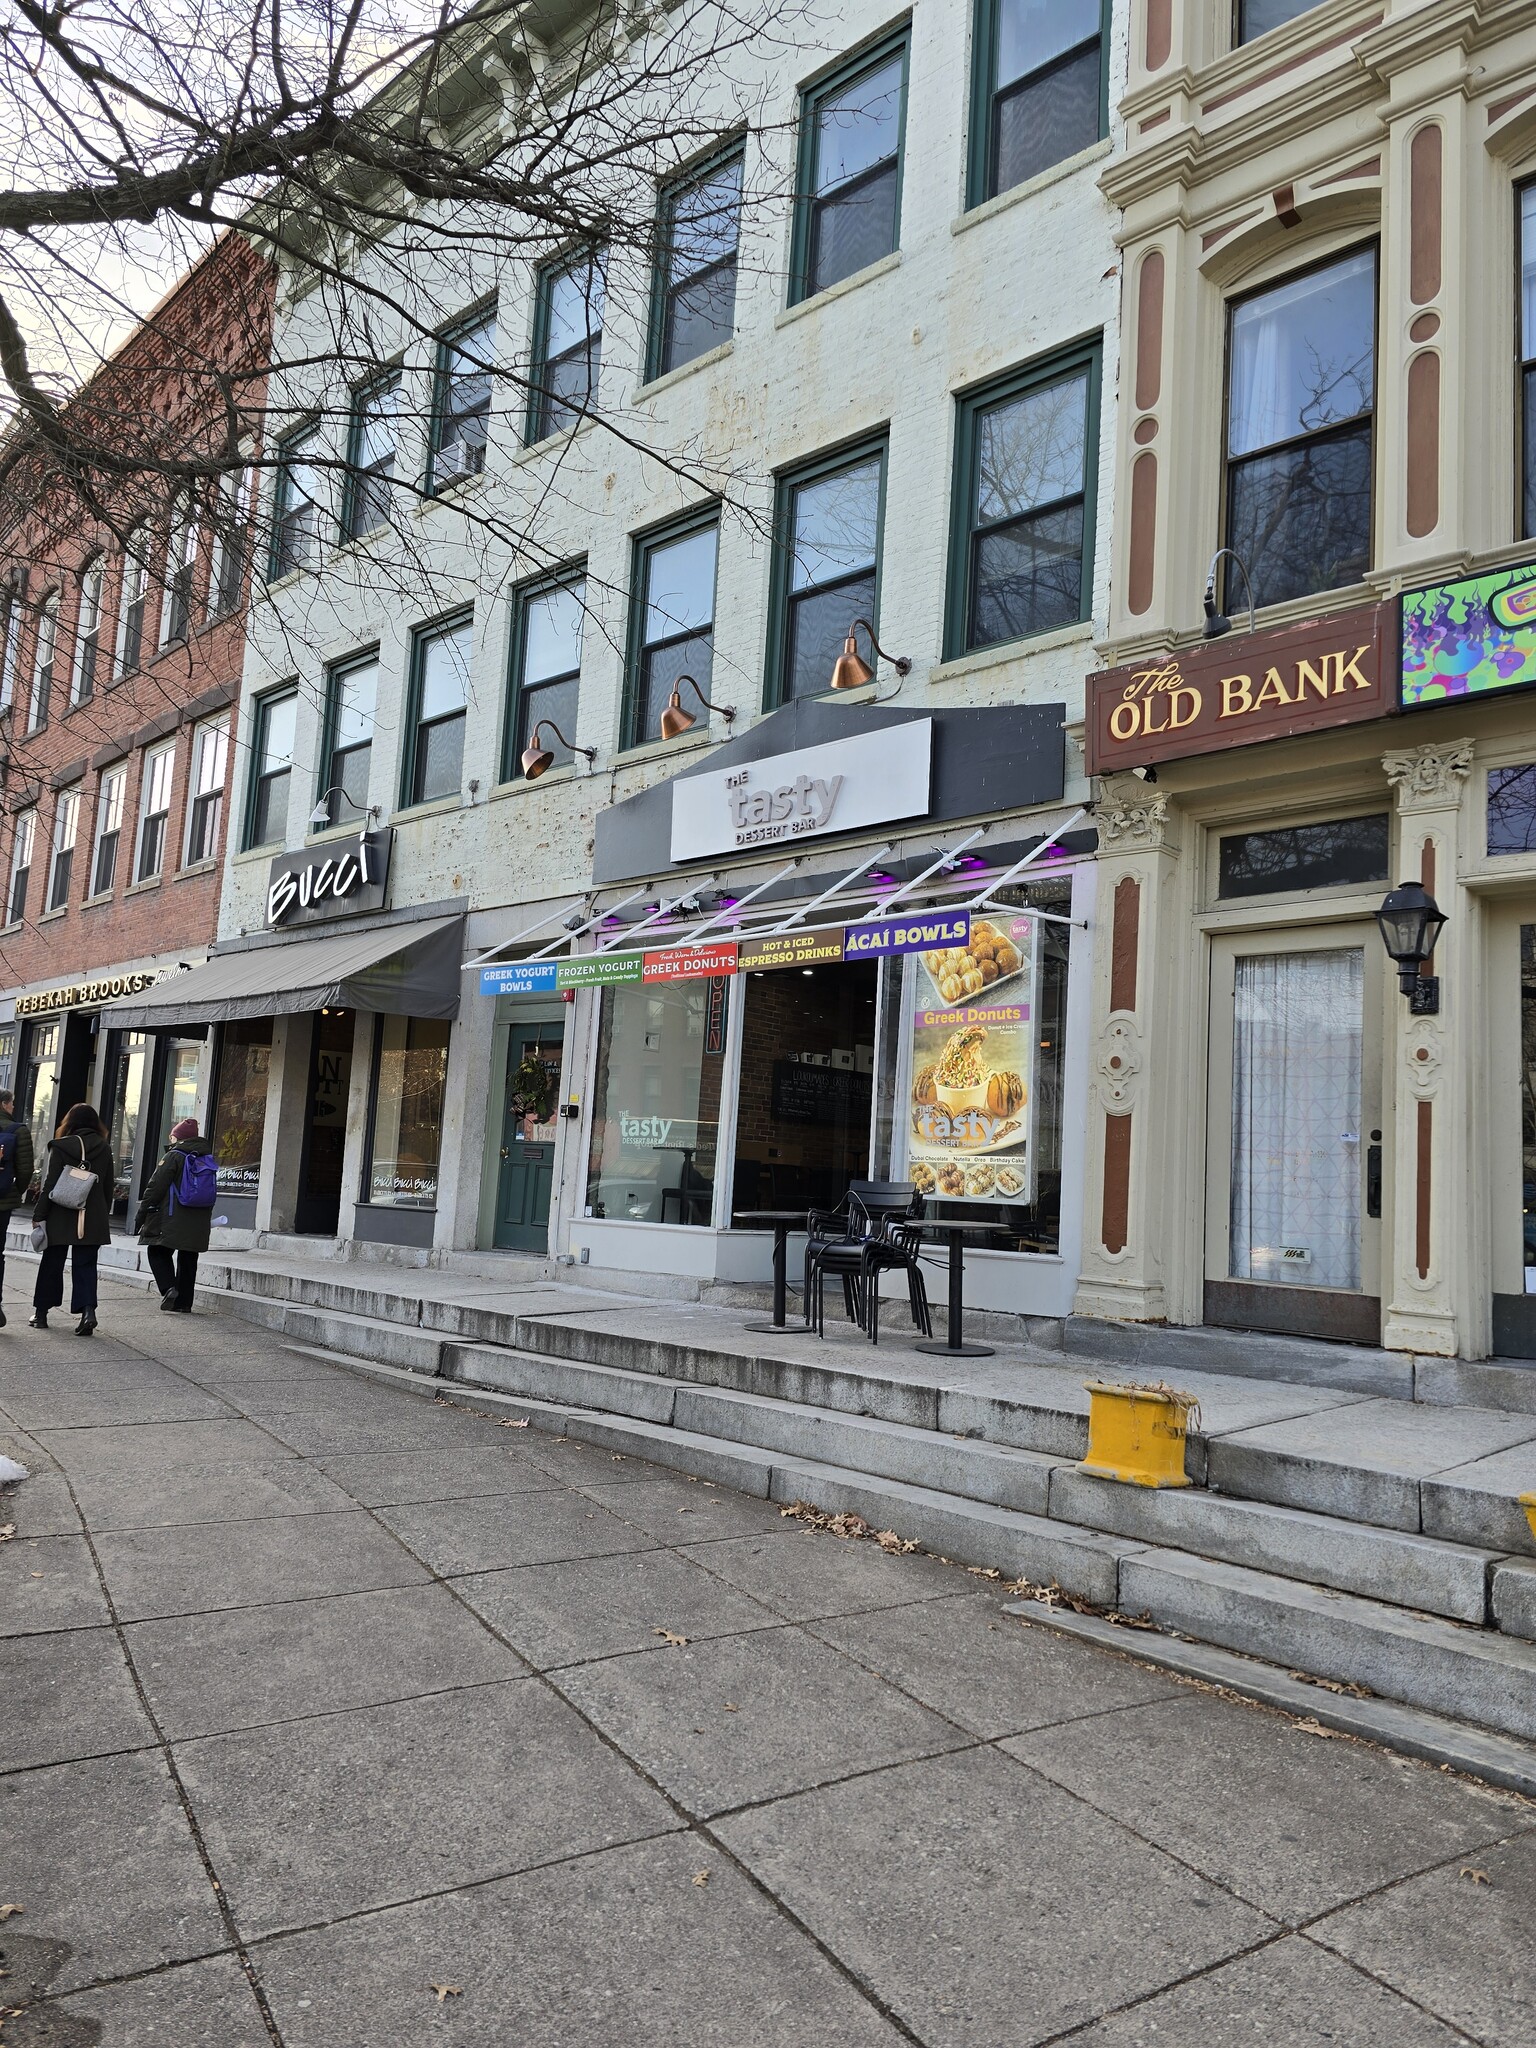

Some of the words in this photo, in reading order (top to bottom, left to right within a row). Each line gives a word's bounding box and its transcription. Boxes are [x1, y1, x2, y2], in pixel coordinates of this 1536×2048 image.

[1122, 662, 1185, 701] The
[1109, 687, 1202, 740] OLD
[1219, 645, 1372, 719] BANK
[724, 770, 749, 789] THE
[728, 775, 846, 828] tasty
[735, 824, 788, 845] DESSERT
[791, 818, 816, 833] BAR
[894, 920, 967, 946] BOWLS
[763, 942, 782, 951] HOT
[783, 940, 790, 948] &
[792, 937, 815, 948] ICED
[643, 960, 680, 975] GREEK
[684, 955, 736, 971] DONUTS
[738, 951, 793, 968] ESPRESSO
[796, 945, 841, 961] DRINKS
[483, 967, 514, 981] GREEK
[515, 966, 555, 979] YOGURT
[558, 964, 596, 978] FROZEN
[599, 960, 641, 973] YOGURT
[15, 987, 73, 1013] REBEKAH
[79, 973, 143, 1003] BROOKS
[500, 981, 532, 993] BOWLS
[709, 975, 724, 1050] OPEN
[923, 1009, 964, 1024] Greek
[967, 1007, 1021, 1022] Donuts
[618, 1109, 630, 1117] THE
[917, 1104, 933, 1114] THE
[620, 1115, 673, 1145] tasty
[921, 1111, 1001, 1147] tasty
[926, 1138, 960, 1147] DESSERT
